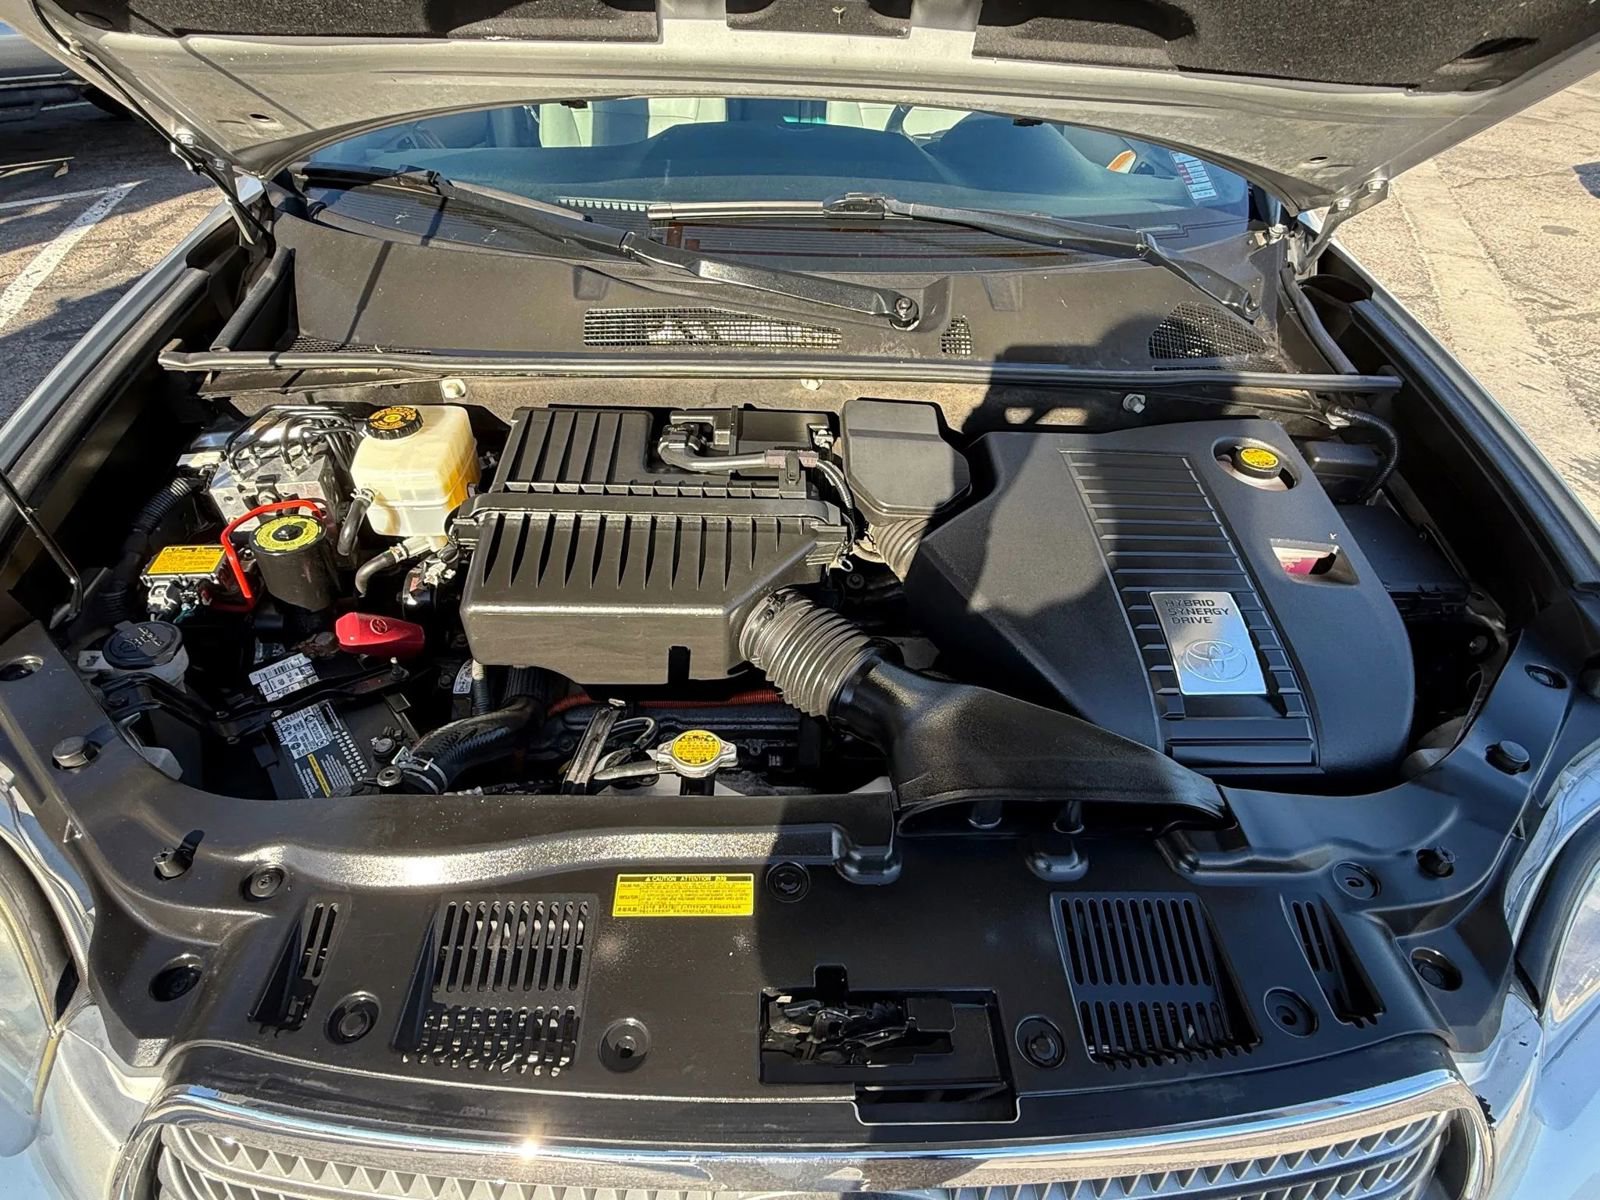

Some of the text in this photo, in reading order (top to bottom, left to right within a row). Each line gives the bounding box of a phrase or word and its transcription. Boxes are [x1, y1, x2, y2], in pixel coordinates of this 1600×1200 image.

[1165, 599, 1216, 607] HYBRID
[1168, 607, 1229, 616] SYNERGY
[1171, 616, 1213, 625] DRIVE
